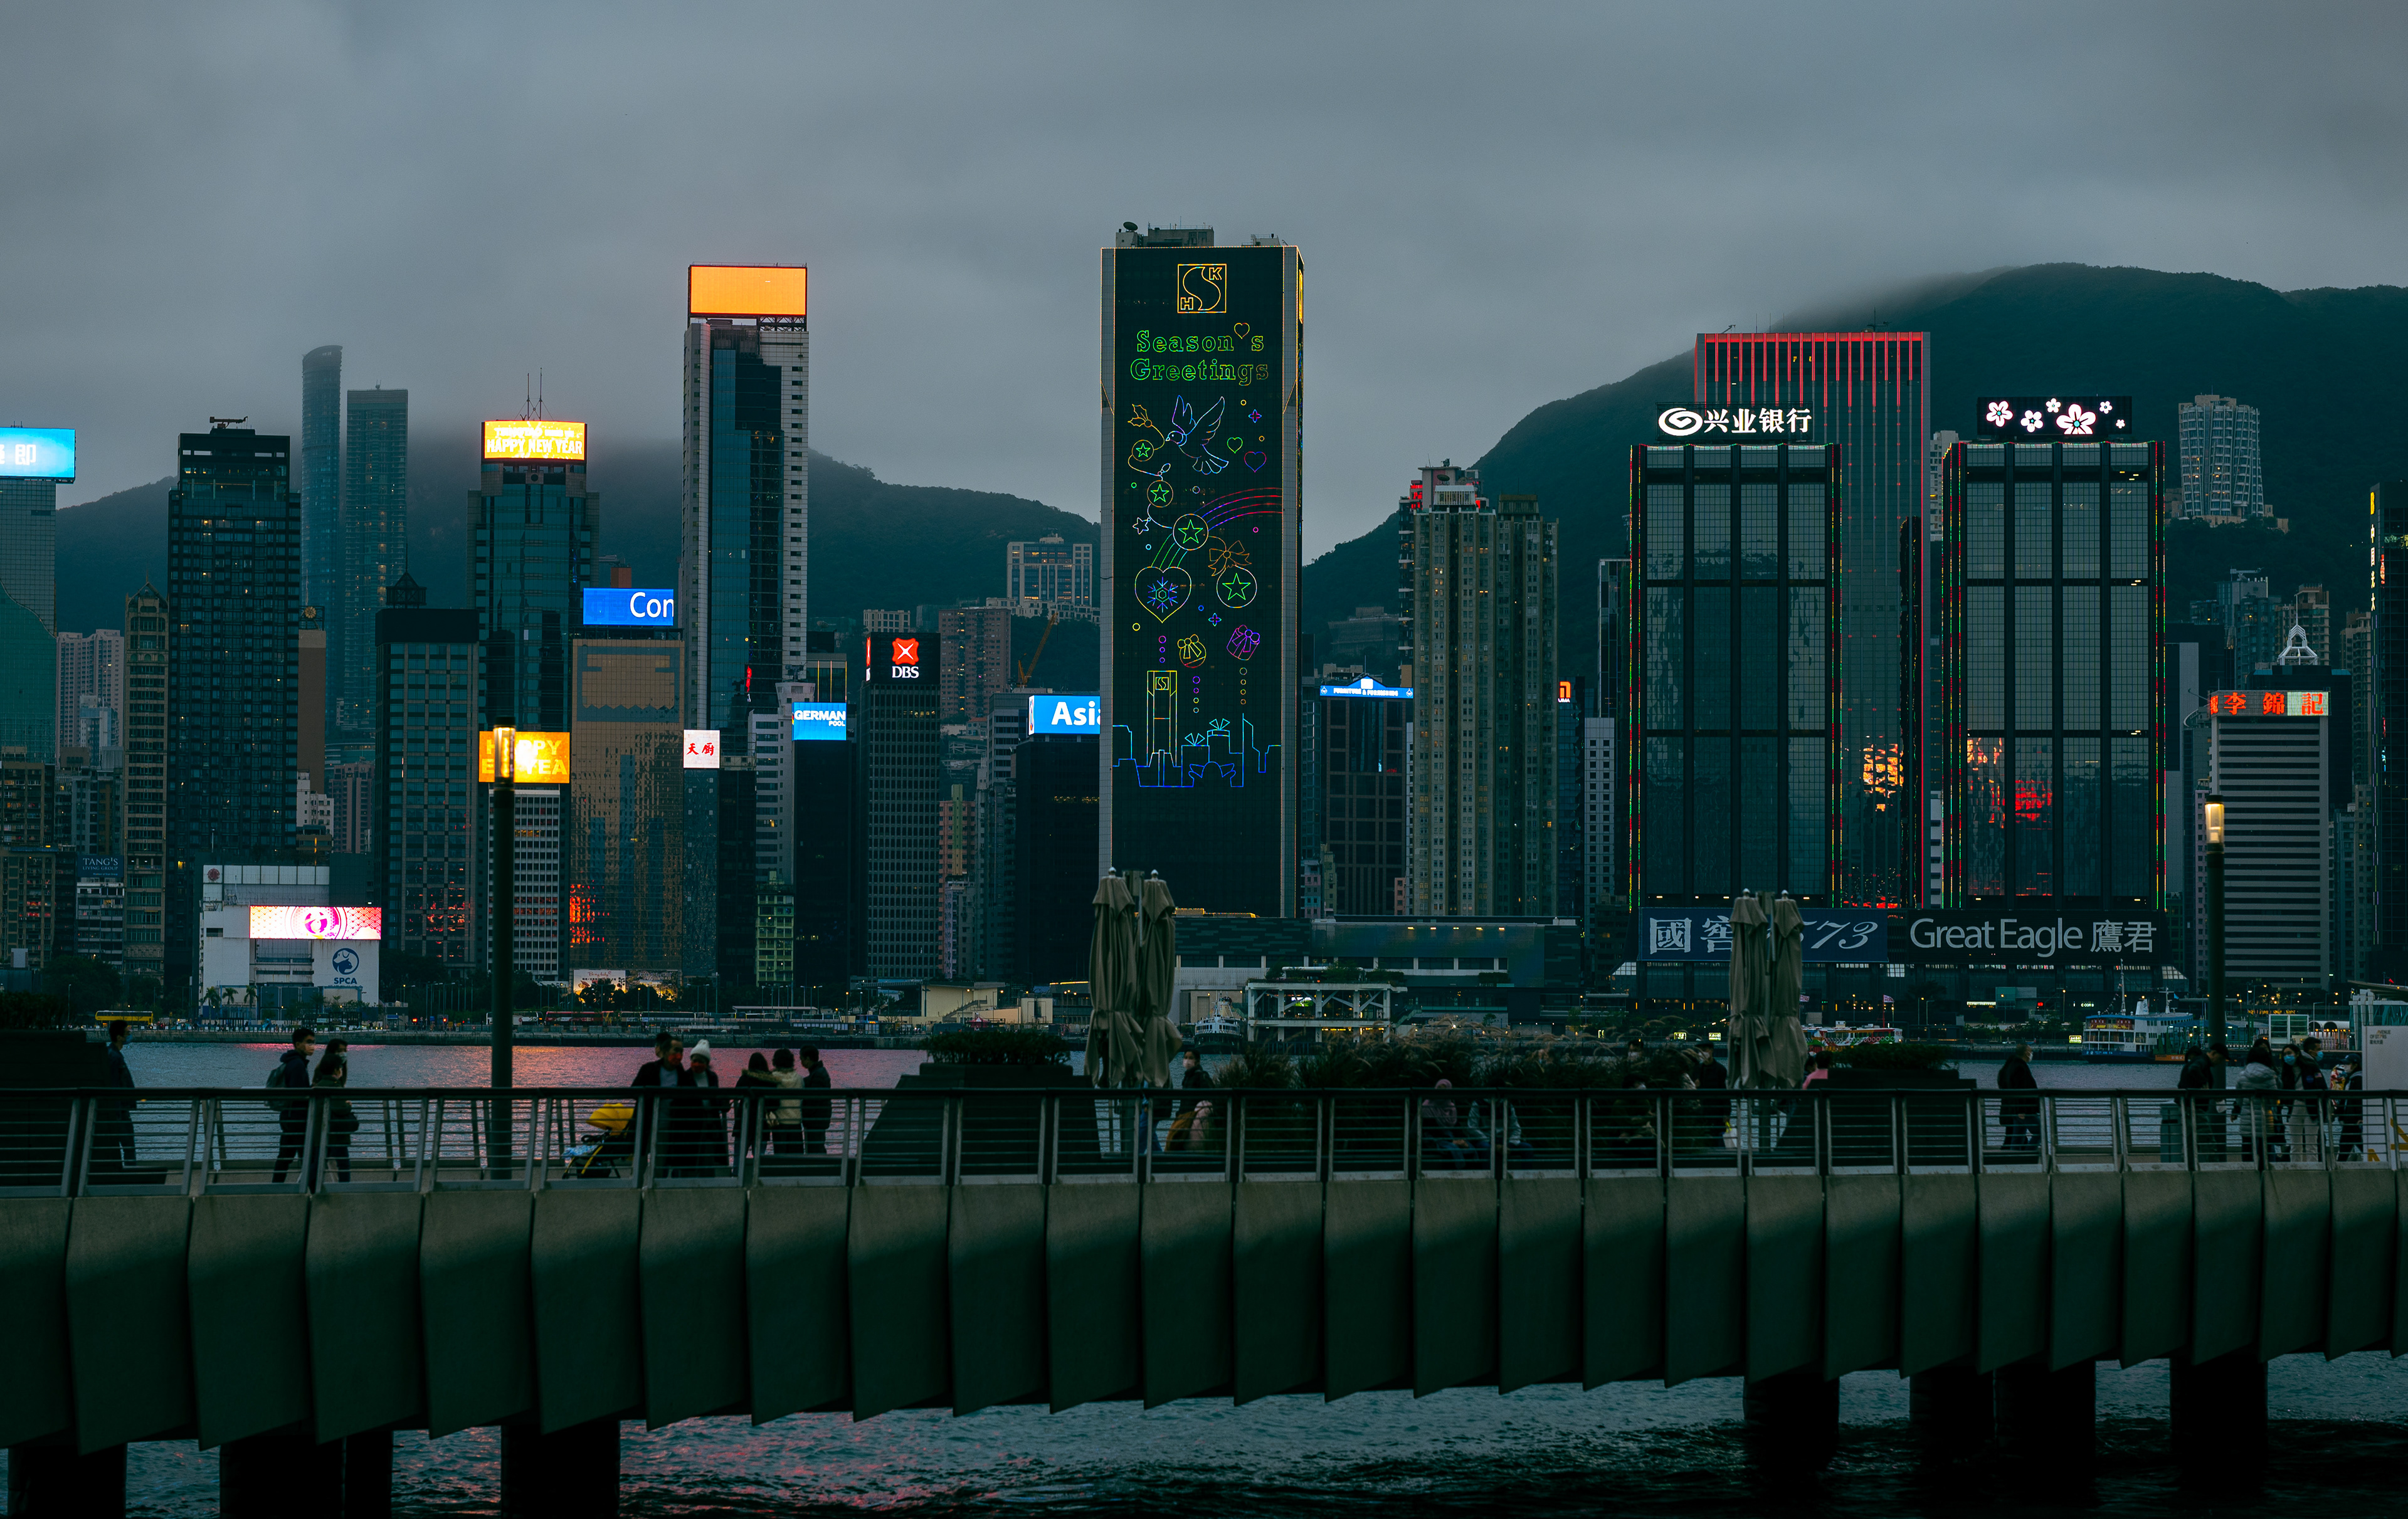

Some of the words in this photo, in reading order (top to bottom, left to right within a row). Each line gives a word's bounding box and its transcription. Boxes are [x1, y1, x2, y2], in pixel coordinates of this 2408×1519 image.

[1130, 359, 1269, 386] Greetings
[1704, 407, 1812, 434] 兴业银行
[487, 439, 525, 453] HAPPY
[529, 439, 552, 453] NEW
[556, 439, 583, 455] YEAR
[892, 666, 919, 678] DBS
[2224, 691, 2324, 715] 李錦記
[794, 710, 846, 720] GERMAN
[487, 740, 562, 755] HPPY
[82, 857, 119, 866] TANG'S
[1910, 918, 1995, 949] Great
[2000, 918, 2083, 957] Eagle
[2089, 920, 2157, 953] 鷹君
